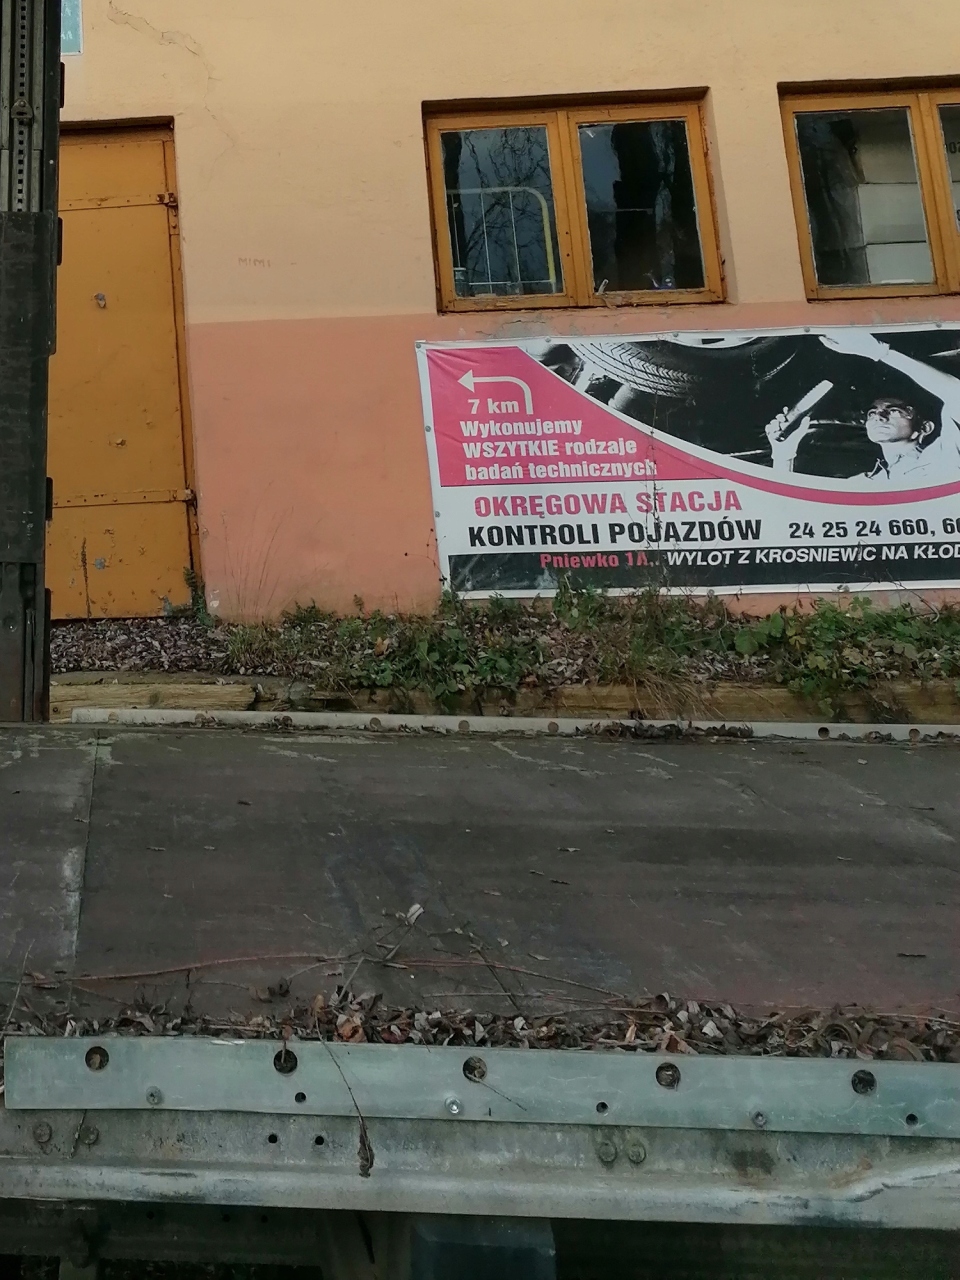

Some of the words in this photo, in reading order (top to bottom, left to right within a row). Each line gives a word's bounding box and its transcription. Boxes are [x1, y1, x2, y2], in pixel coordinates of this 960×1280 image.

[467, 398, 480, 415] 7
[487, 398, 519, 414] km
[460, 419, 582, 438] Wykonujemy
[462, 439, 559, 458] WSZYTKIE
[565, 437, 637, 456] rodzaje
[465, 462, 523, 480] badań
[528, 459, 658, 478] technicznych
[474, 493, 627, 518] OKRĘGOWA
[637, 490, 742, 513] STACJA
[468, 523, 599, 547] KONTROLI
[609, 516, 762, 543] POJAZDÓW
[788, 522, 815, 539] 24
[822, 521, 848, 538] 25
[855, 520, 882, 537] 24
[889, 518, 936, 537] 660,
[540, 553, 619, 569] Pniewko
[666, 550, 734, 566] WYLOT
[737, 550, 751, 564] Z
[755, 547, 877, 564] KROSNIEWIC
[881, 545, 909, 560] NA
